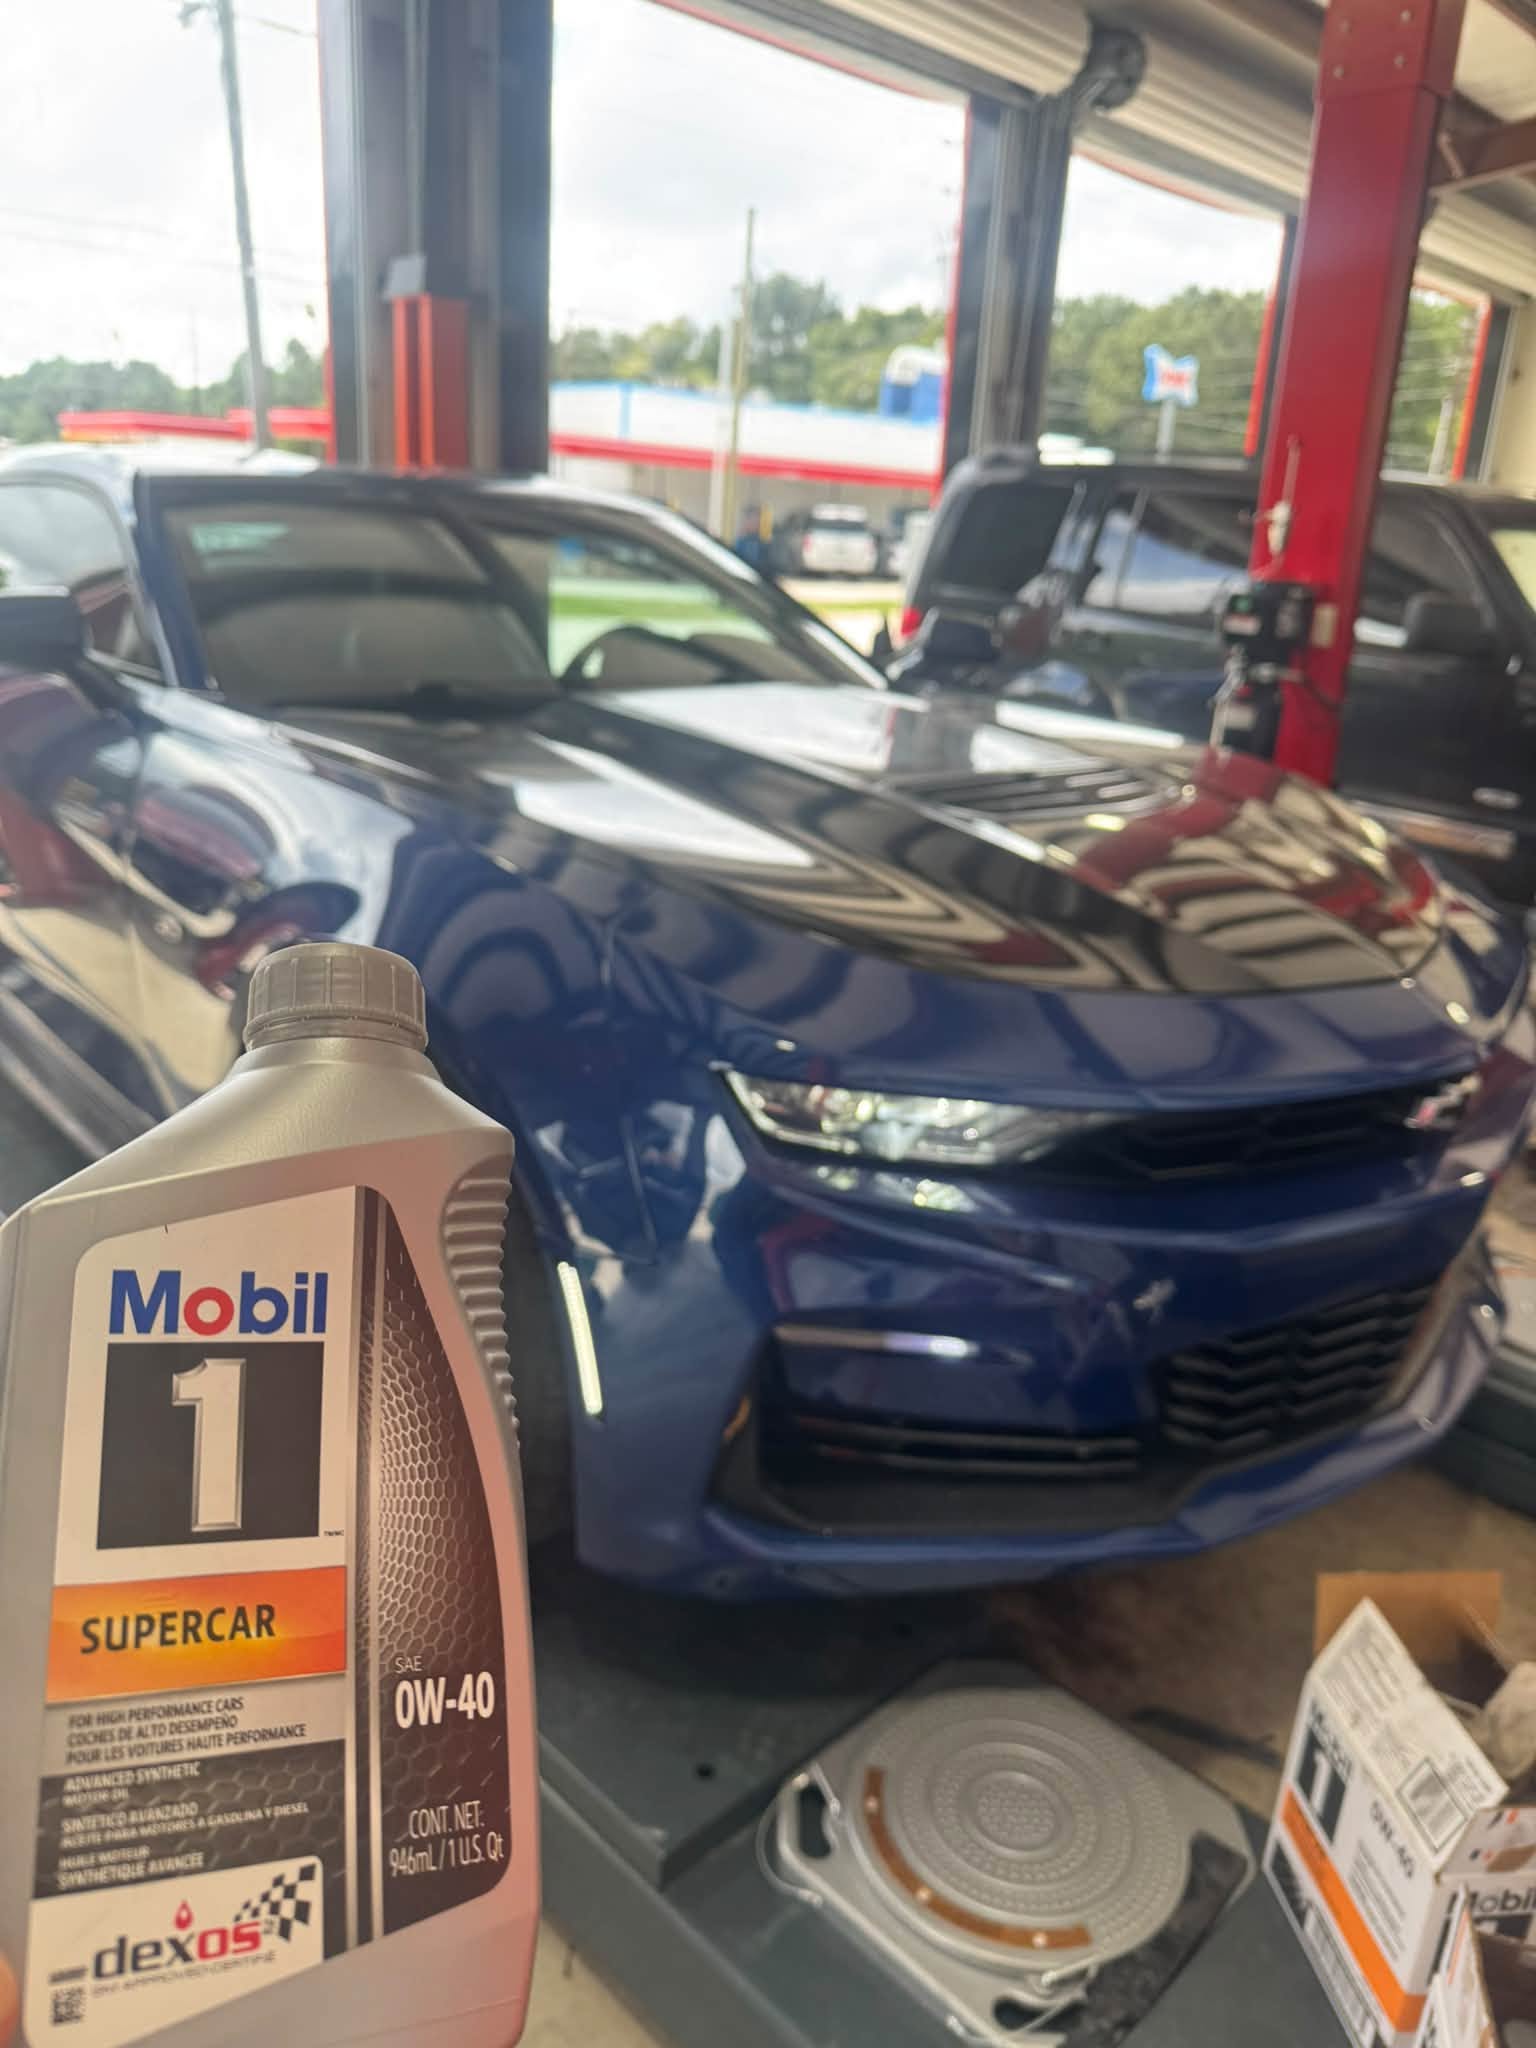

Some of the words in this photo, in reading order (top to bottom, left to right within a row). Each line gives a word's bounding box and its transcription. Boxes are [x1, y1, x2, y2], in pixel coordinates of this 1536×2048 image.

[109, 1269, 328, 1335] Mobil
[172, 1357, 247, 1532] 1
[80, 1604, 276, 1655] SUPERCAR
[395, 1656, 423, 1674] SAE
[68, 1713, 93, 1728] FOR
[96, 1709, 126, 1725] HIGH
[128, 1700, 213, 1721] PERFORMANCE
[215, 1696, 244, 1713] CARS
[395, 1671, 495, 1729] 0W-40
[66, 1747, 102, 1764] POUR
[103, 1744, 125, 1762] LES
[127, 1735, 184, 1758] VOITURES
[186, 1733, 224, 1753] HAUTE
[225, 1723, 307, 1747] PERFORMANCE
[67, 1729, 115, 1748] COCHES
[117, 1726, 133, 1742] DE
[136, 1722, 167, 1740] ALTO
[64, 1770, 134, 1791] ADVANCED
[135, 1761, 201, 1785] SYNTHETIC
[111, 1788, 129, 1800] OIL
[128, 1802, 199, 1822] AVANZADO
[197, 1817, 206, 1829] A
[207, 1808, 263, 1826] GASOLINA
[272, 1802, 309, 1817] DIESEL
[408, 1805, 453, 1840] CONT.
[453, 1799, 485, 1831] NET.
[486, 1831, 505, 1862] Qt
